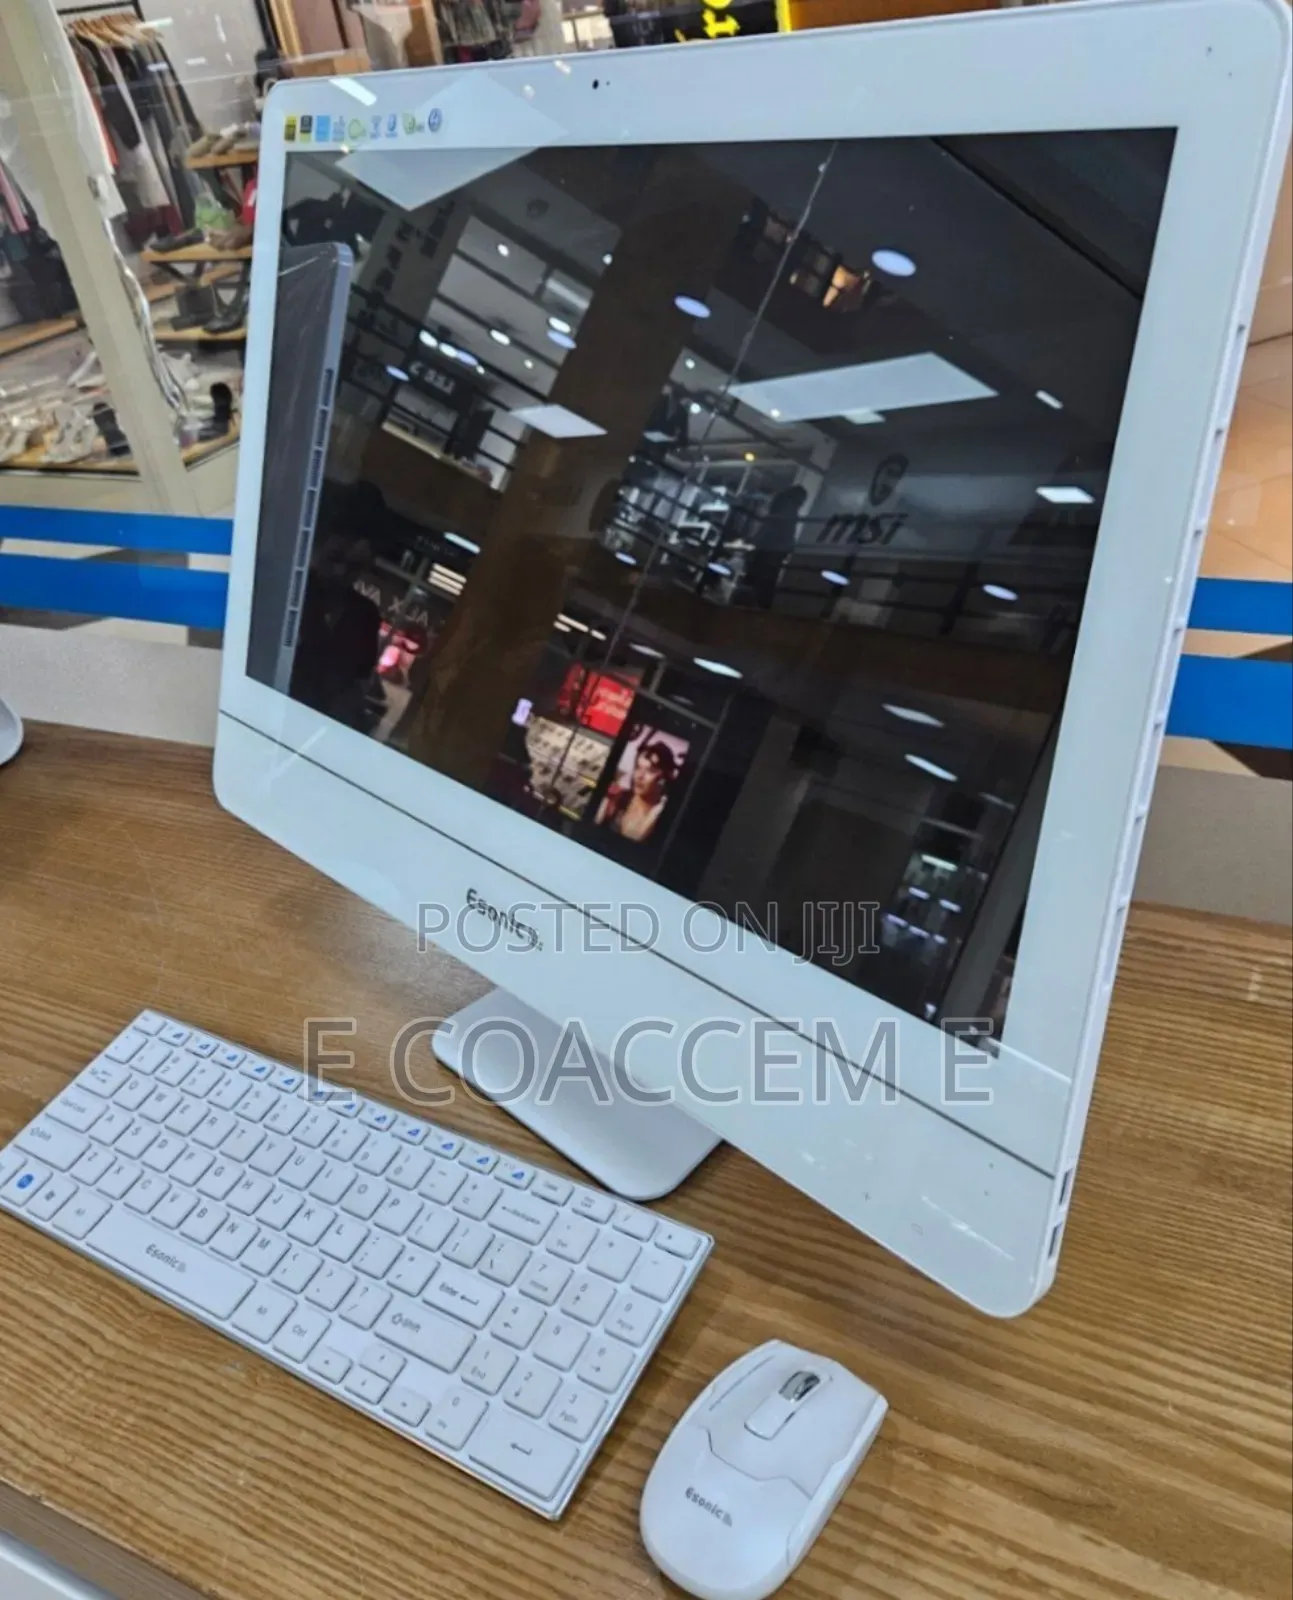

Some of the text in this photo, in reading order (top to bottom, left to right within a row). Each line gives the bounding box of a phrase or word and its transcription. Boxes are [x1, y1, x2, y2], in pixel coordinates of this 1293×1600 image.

[466, 887, 526, 942] Esonic
[145, 1243, 178, 1269] Esonic
[685, 1486, 724, 1520] Esonic
